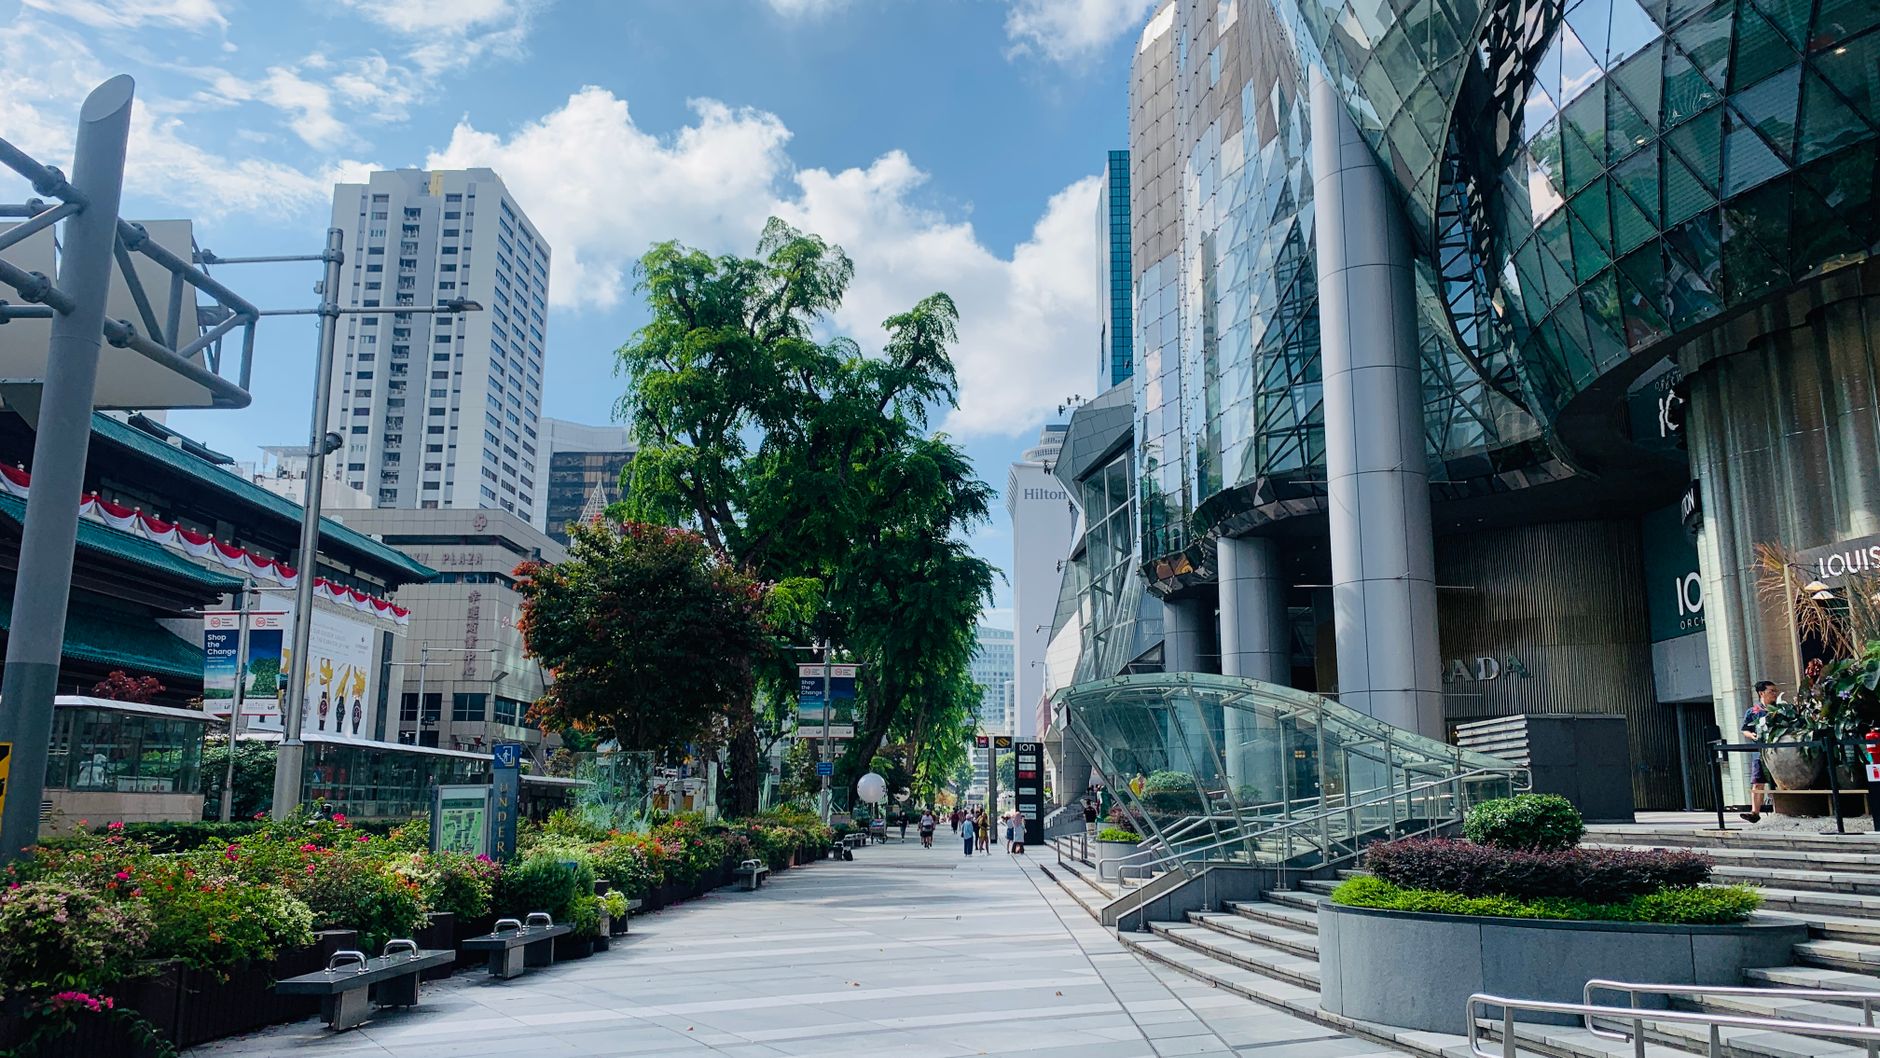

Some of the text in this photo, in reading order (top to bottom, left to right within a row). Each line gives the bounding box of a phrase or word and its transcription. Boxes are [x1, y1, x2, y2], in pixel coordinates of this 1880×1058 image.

[1023, 488, 1066, 500] Hilton
[442, 552, 483, 565] PLAZA
[1818, 545, 1880, 579] LOUIS
[207, 648, 237, 657] Change
[1440, 655, 1533, 683] ADA
